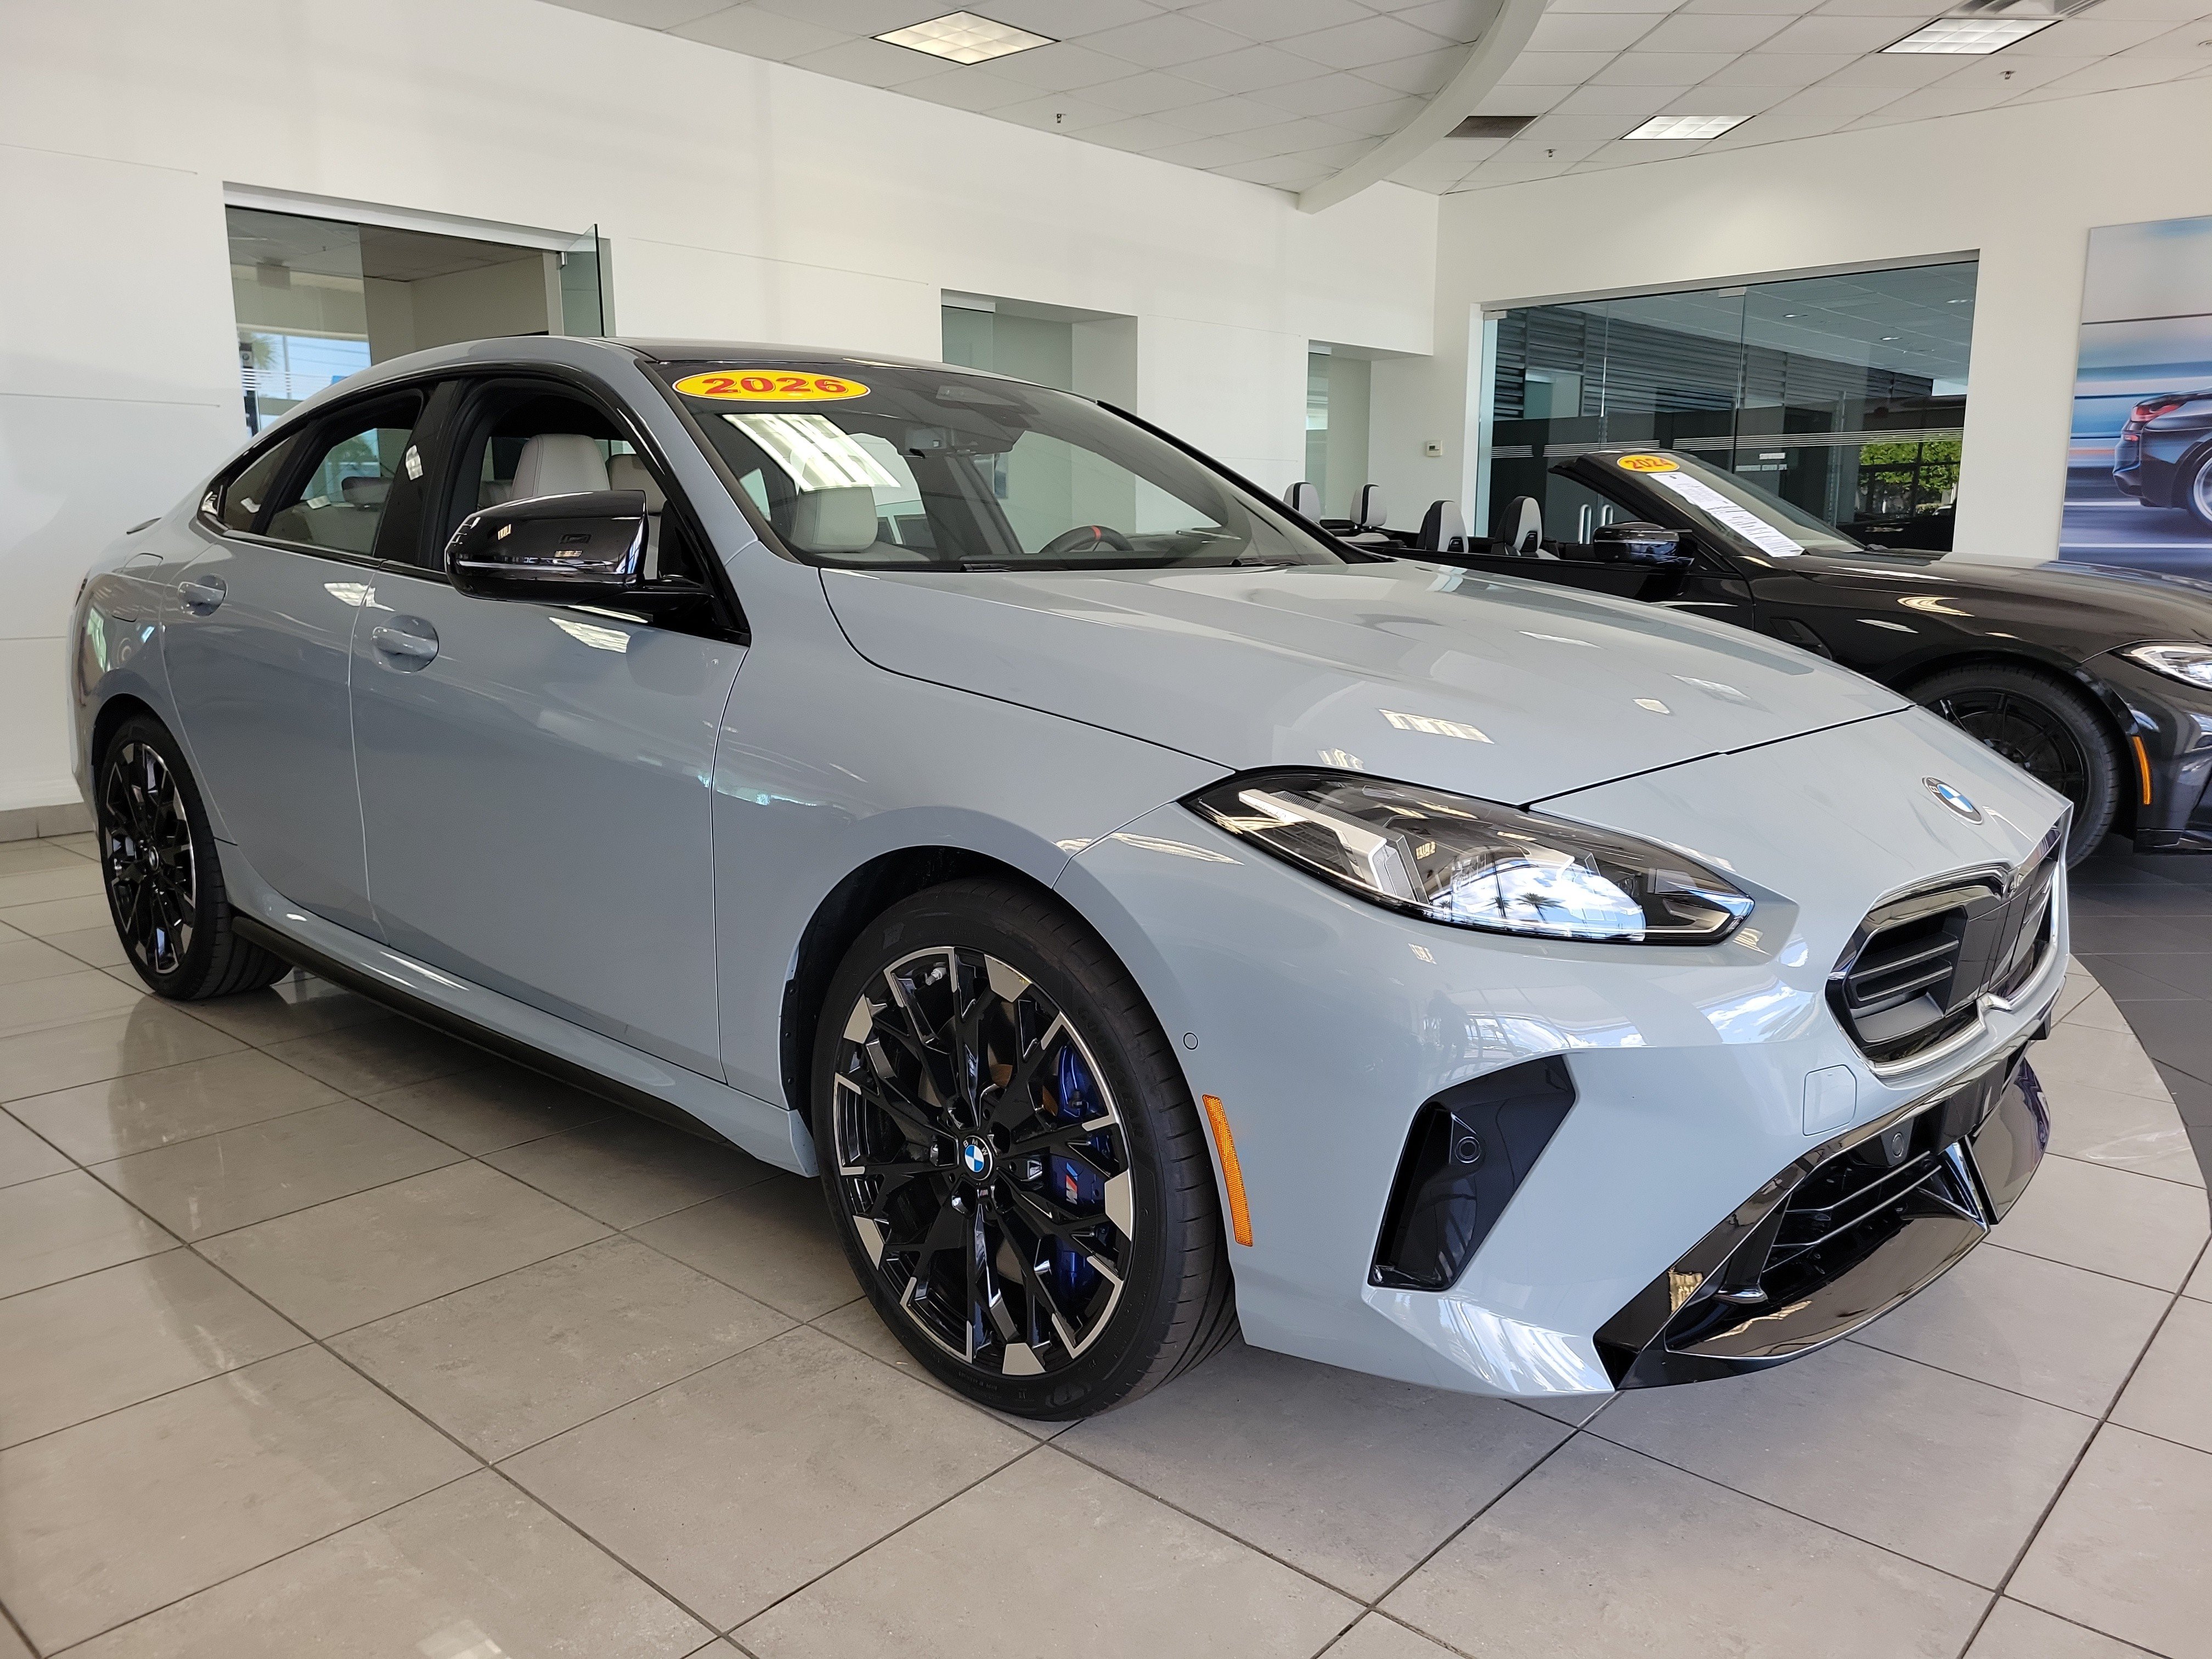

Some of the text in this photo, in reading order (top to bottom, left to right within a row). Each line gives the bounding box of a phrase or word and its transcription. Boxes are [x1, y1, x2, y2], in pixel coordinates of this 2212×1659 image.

[702, 377, 848, 394] 2026
[1624, 458, 1673, 470] 2024
[963, 1138, 989, 1156] BMW
